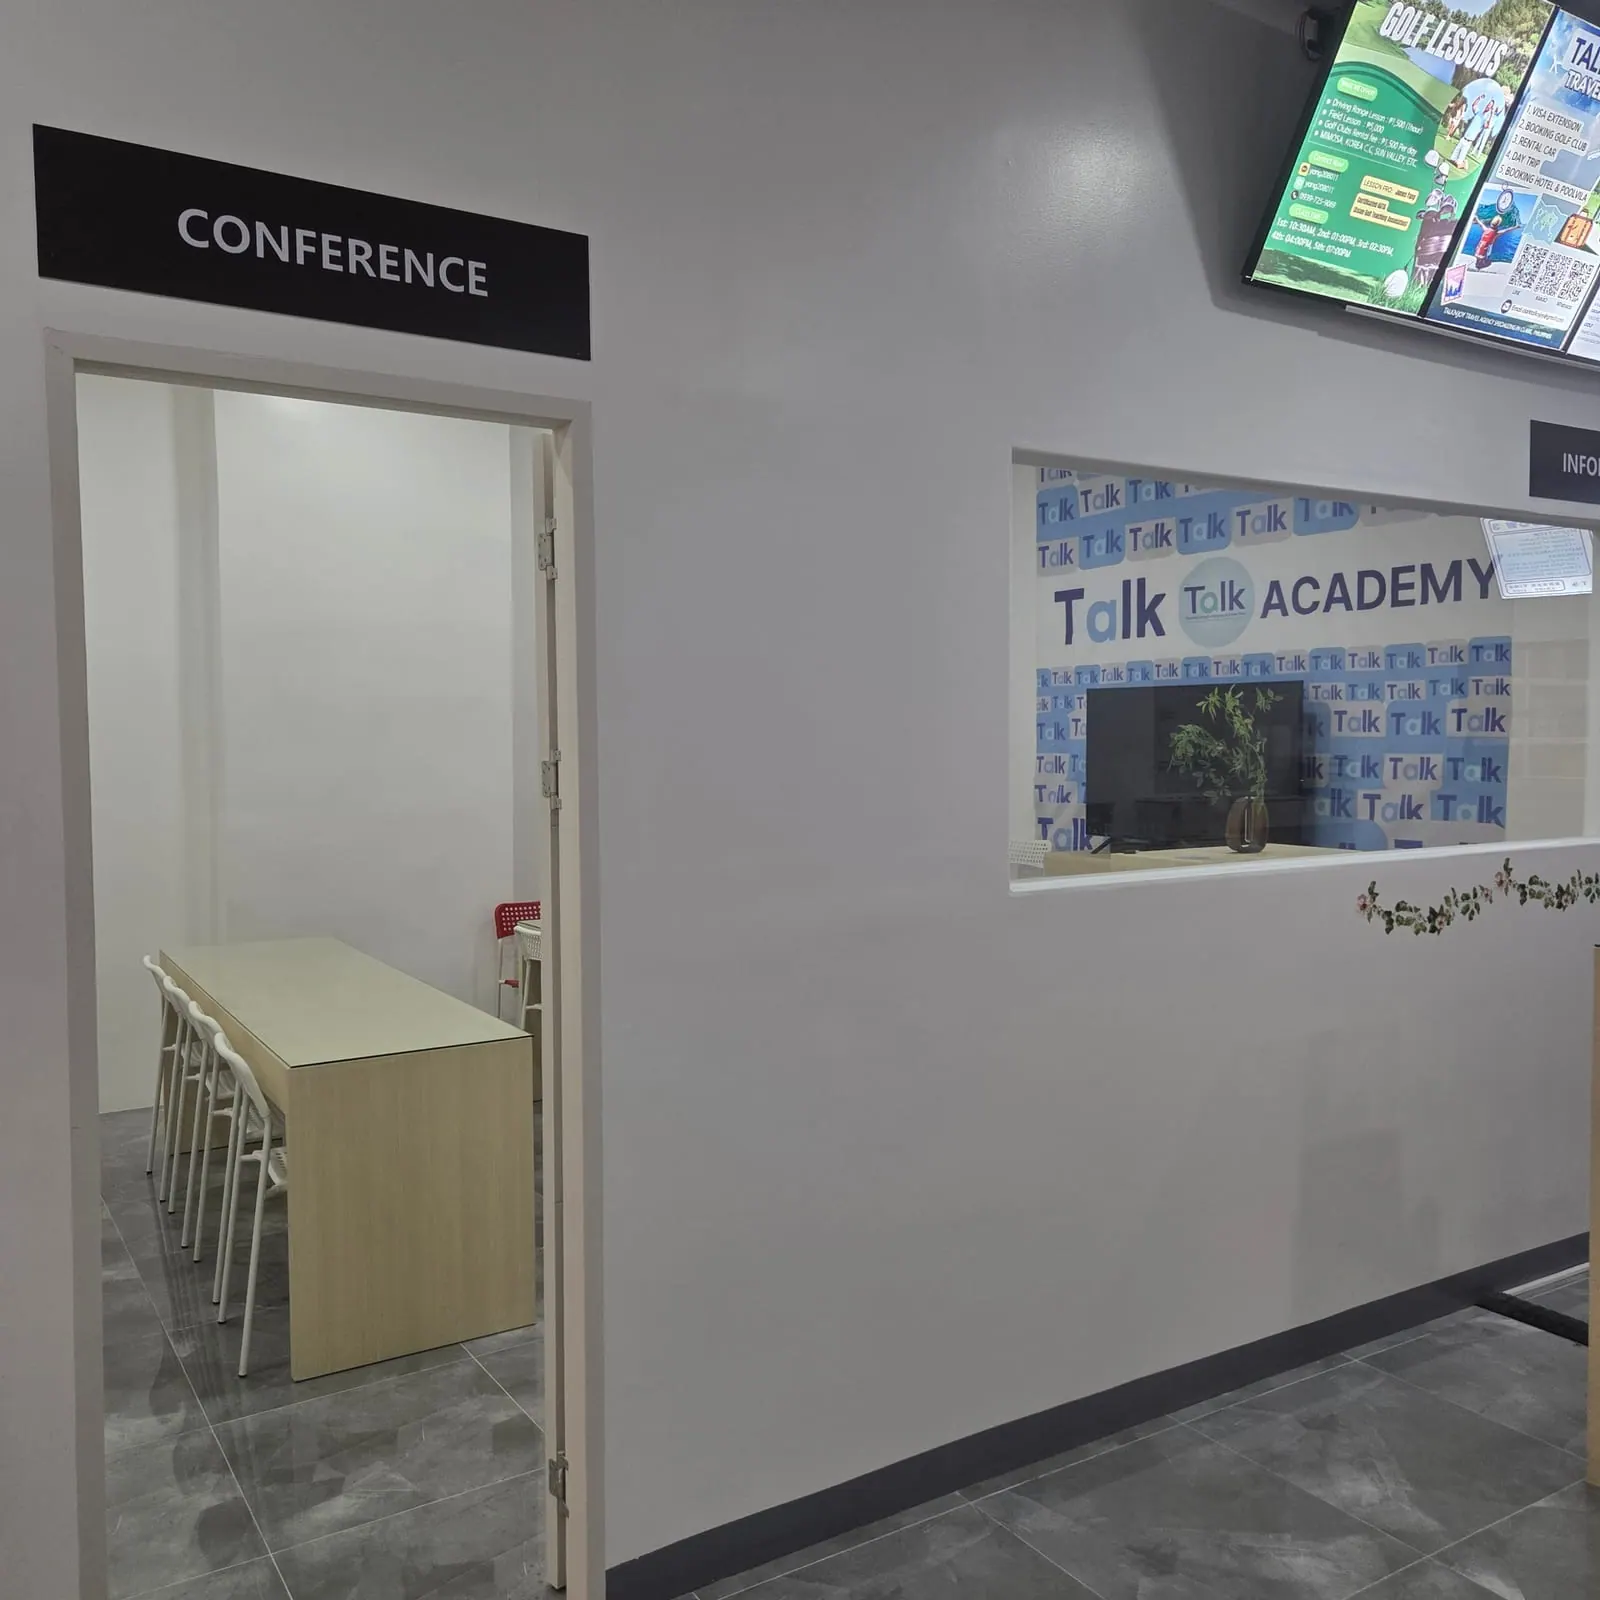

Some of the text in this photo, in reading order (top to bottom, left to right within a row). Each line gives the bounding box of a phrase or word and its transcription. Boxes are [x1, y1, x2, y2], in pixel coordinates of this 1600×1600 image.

[1380, 2, 1508, 76] GOLF LESSONS
[1571, 37, 1600, 74] TAL
[1327, 109, 1343, 120] Field
[1342, 114, 1362, 126] Lesson
[1330, 98, 1352, 113] Driving
[1368, 110, 1386, 122] Lesson
[1532, 107, 1547, 119] VISA
[1547, 112, 1583, 132] EXTENSION
[1323, 120, 1337, 130] Golf
[1336, 124, 1352, 135] Clubs
[1525, 122, 1554, 139] BOOKING
[1555, 132, 1571, 144] GOLF
[1571, 139, 1587, 151] CLUB
[1344, 138, 1364, 151] KOREA
[1373, 147, 1386, 157] SUN
[1512, 152, 1526, 162] DAY
[1527, 156, 1540, 167] TRIP
[1520, 137, 1542, 152] RENTAL
[1543, 145, 1557, 157] CAR
[1362, 179, 1381, 189] LESSON
[1505, 167, 1535, 184] BOOKING
[1534, 177, 1554, 191] HOTEL
[1555, 183, 1560, 192] &
[178, 208, 488, 297] CONFERENCE
[1038, 479, 1172, 525] Talk Talk Talk
[1038, 542, 1074, 568] Talk
[1082, 528, 1122, 558] Talk
[1128, 522, 1172, 551] Talk
[1179, 512, 1226, 543] Talk
[1236, 503, 1288, 537] Talk
[1054, 558, 1495, 645] Talk Talk ACADEMY
[1052, 671, 1072, 685] Talk
[1076, 670, 1098, 685] Talk
[1101, 667, 1123, 682] Talk
[1128, 668, 1150, 683] Talk
[1155, 663, 1178, 678] Talk
[1184, 662, 1208, 677] Talk
[1213, 659, 1240, 676] Talk
[1244, 659, 1271, 677] Talk
[1276, 655, 1306, 672] Talk
[1312, 654, 1342, 671] Talk
[1348, 652, 1381, 669] Talk
[1386, 652, 1420, 670] Talk
[1427, 645, 1464, 665] Talk
[1472, 643, 1510, 663] Talk
[1312, 683, 1343, 700] Talk
[1348, 681, 1381, 700] Talk
[1387, 683, 1421, 699] Talk
[1429, 677, 1465, 697] Talk
[1472, 677, 1511, 697] Talk
[1037, 722, 1065, 740] Talk
[1334, 709, 1381, 733] Talk
[1391, 711, 1441, 736] Talk
[1451, 707, 1506, 733] Talk
[1036, 756, 1065, 774] Talk
[1334, 754, 1379, 779] Talk
[1389, 756, 1438, 780] Talk
[1447, 757, 1502, 783] Talk
[1035, 785, 1071, 803] Talk
[1314, 788, 1505, 829] alk Talk Talk
[1037, 817, 1093, 851] Talk
